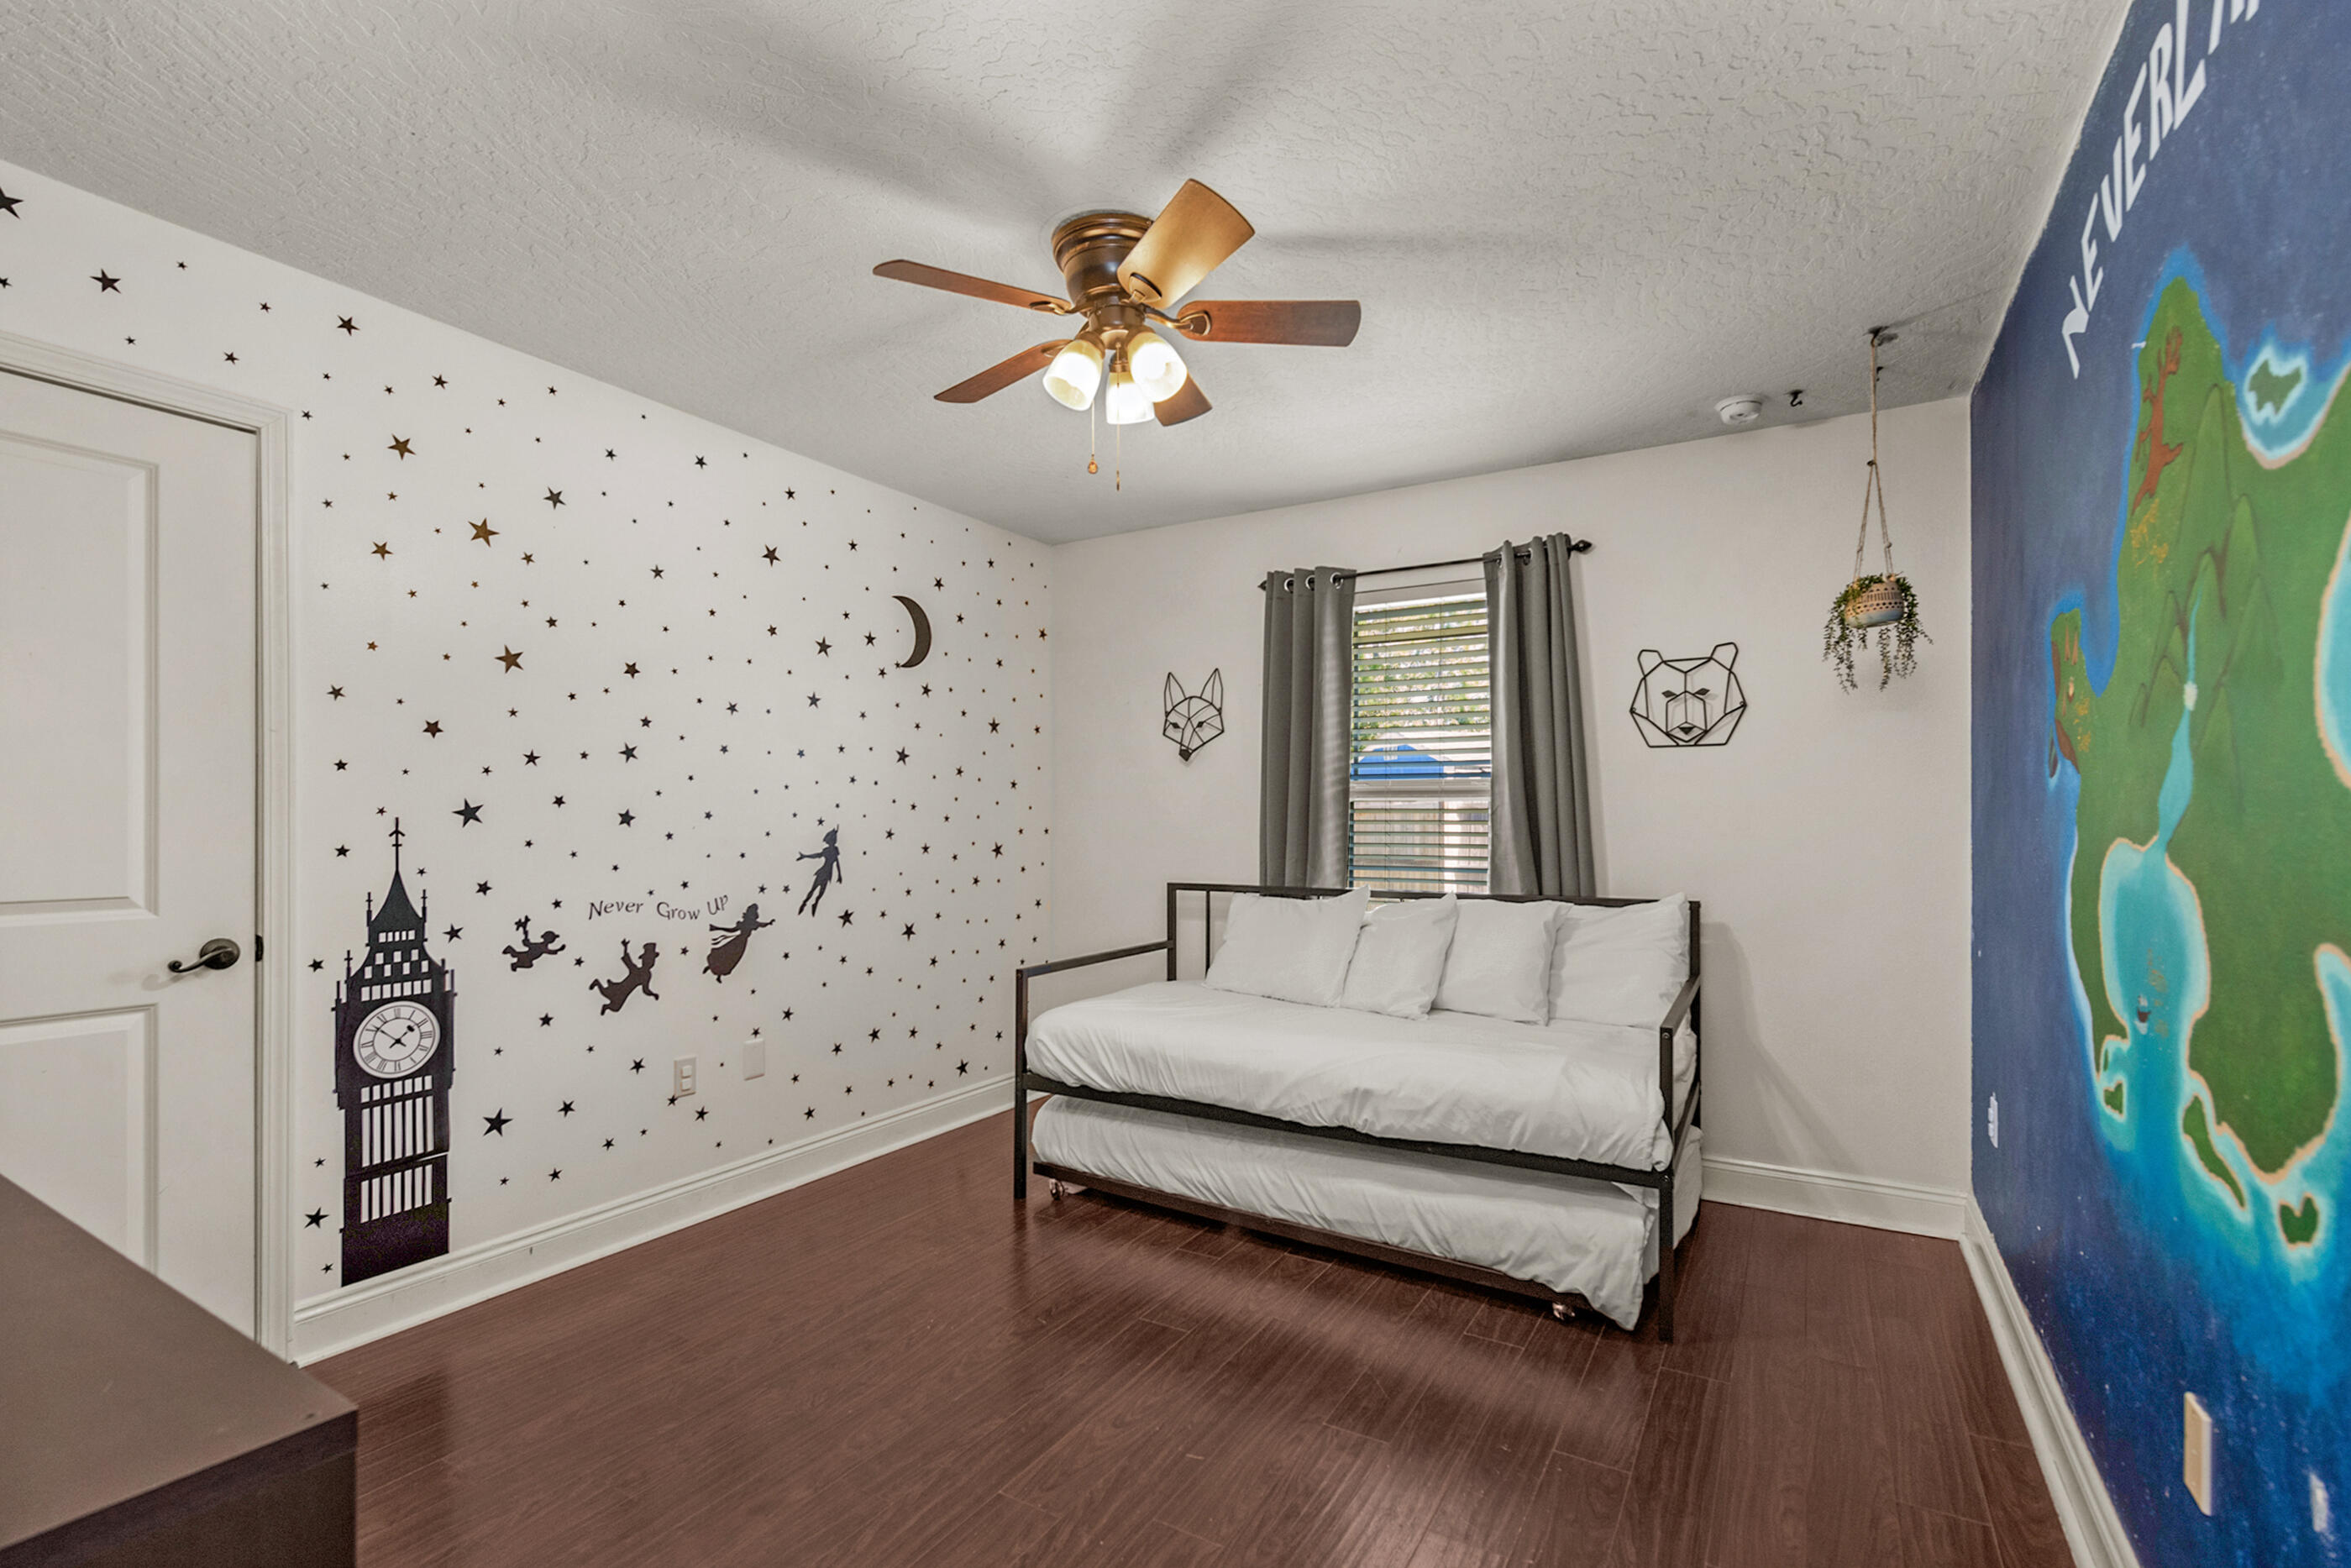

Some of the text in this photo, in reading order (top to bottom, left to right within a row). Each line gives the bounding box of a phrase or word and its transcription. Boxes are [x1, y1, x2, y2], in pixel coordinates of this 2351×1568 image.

[2061, 0, 2259, 379] NEVERL
[588, 900, 643, 920] Never
[656, 901, 701, 920] Grow
